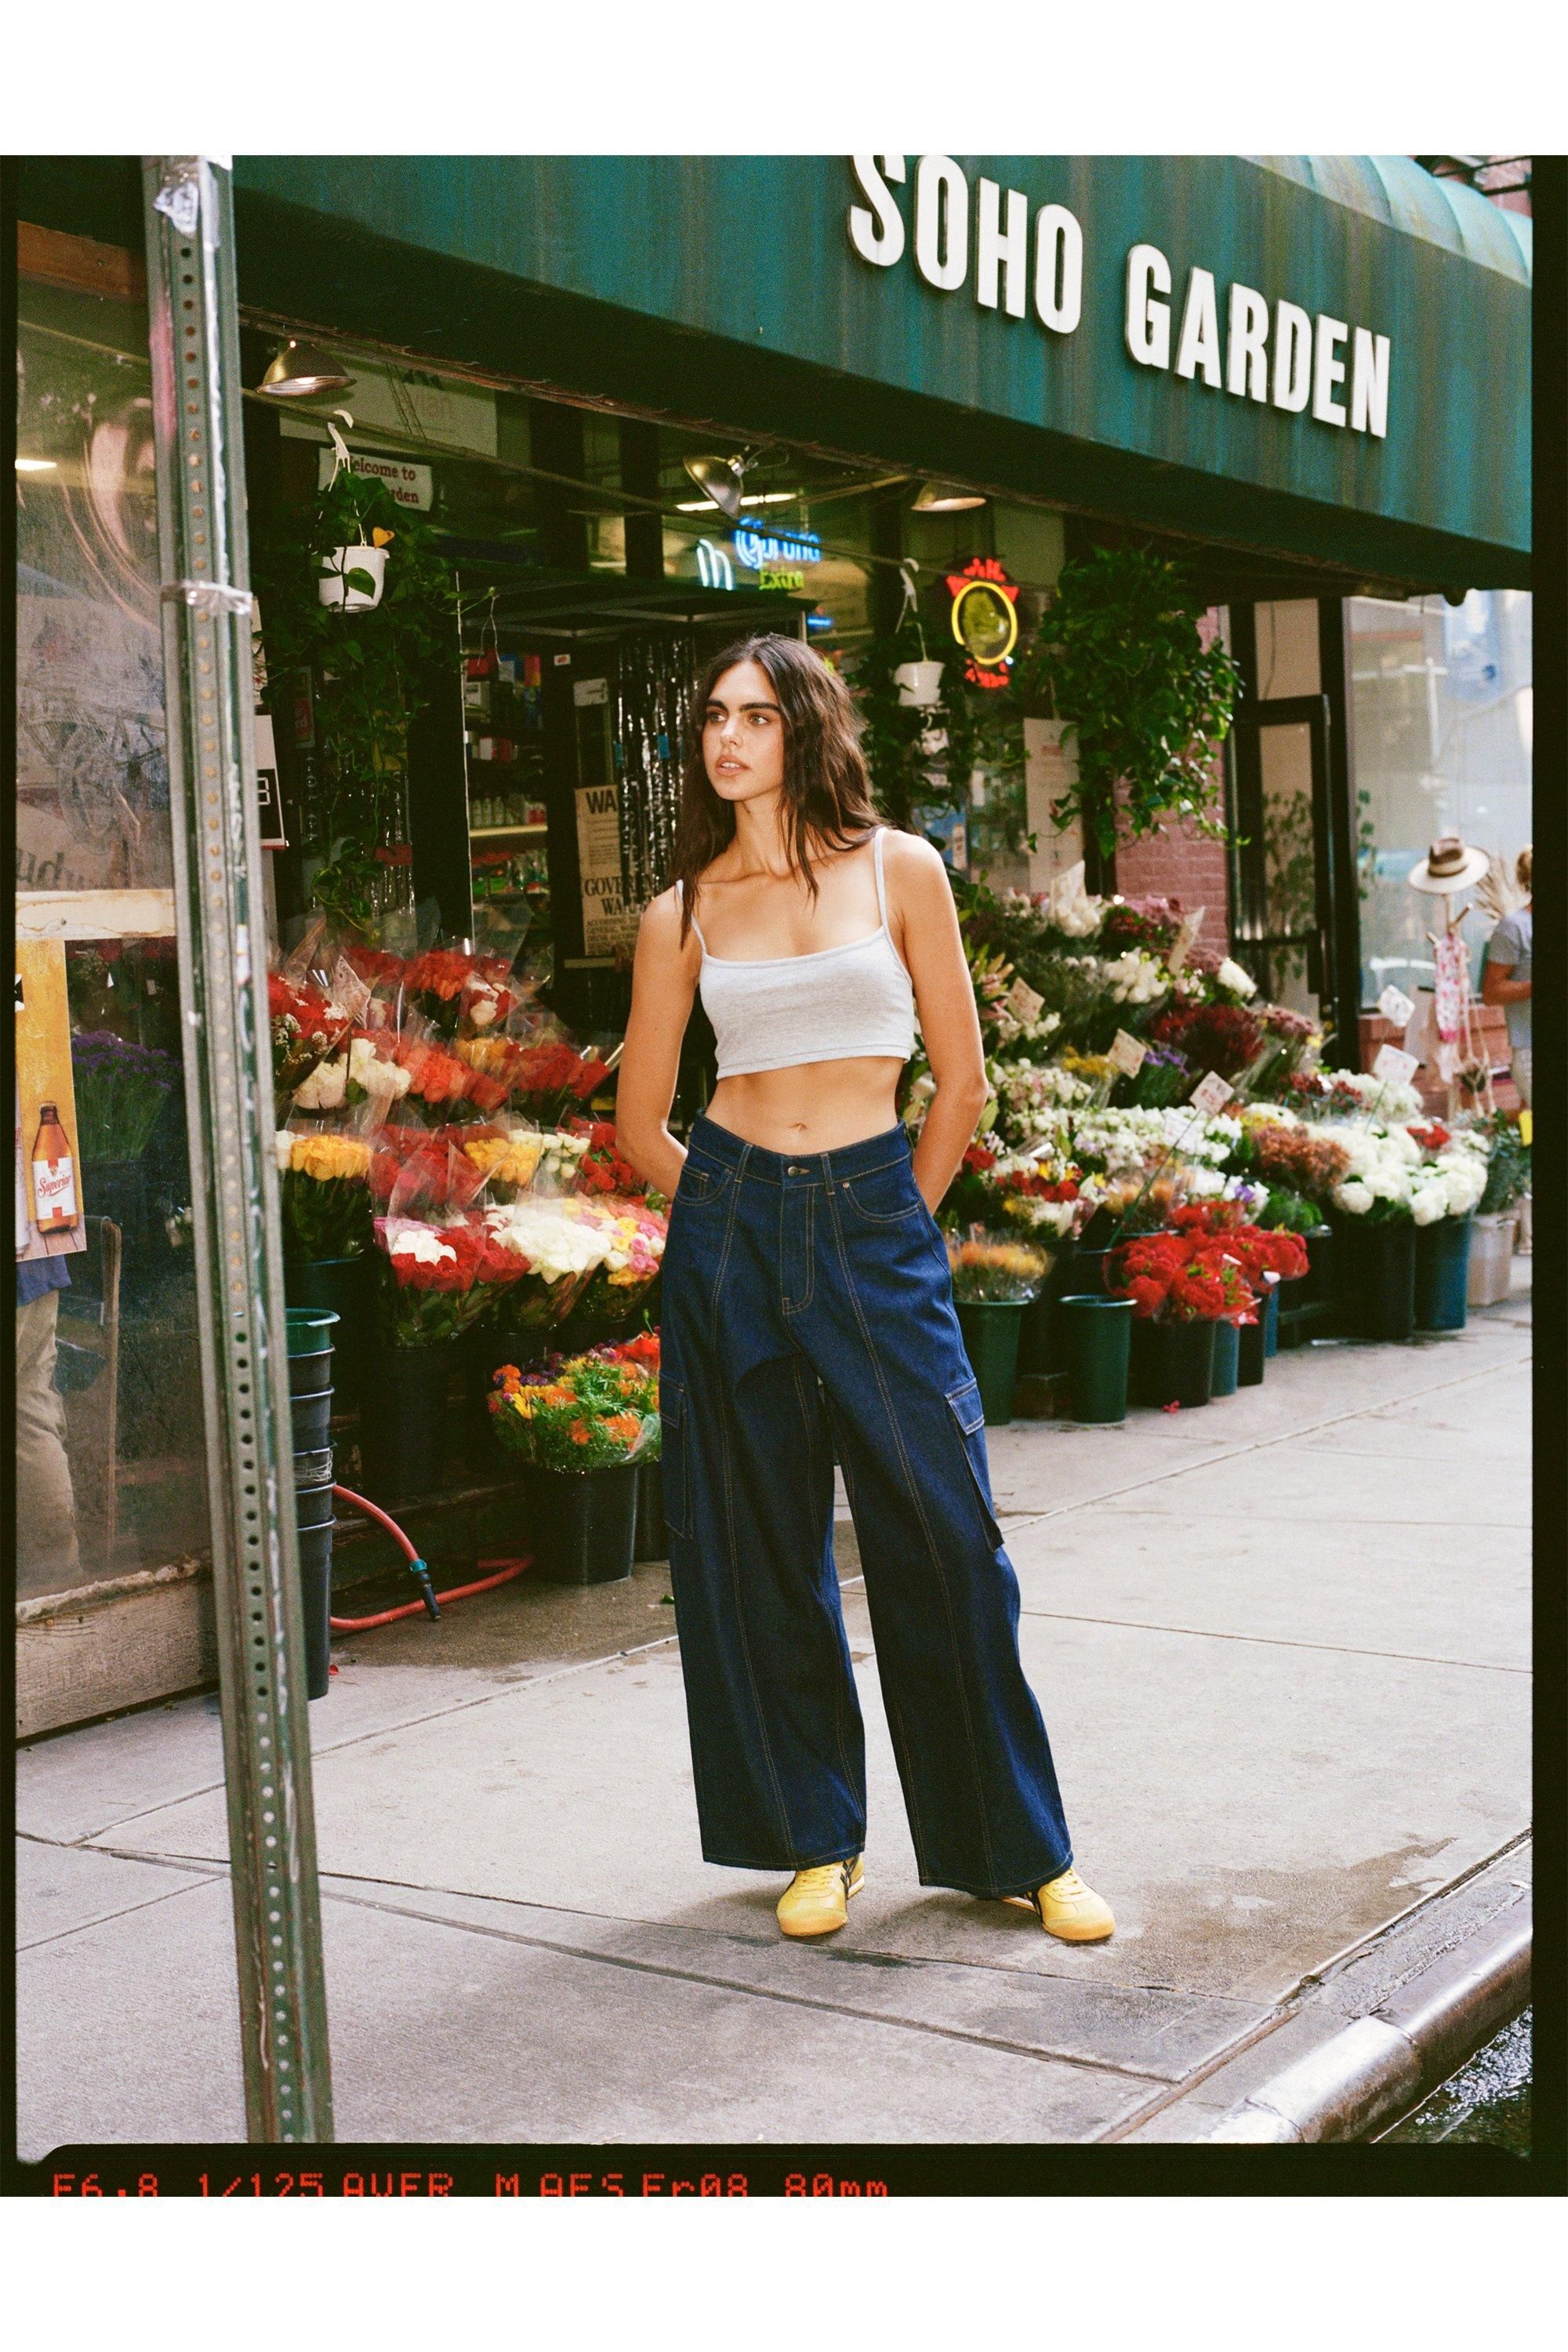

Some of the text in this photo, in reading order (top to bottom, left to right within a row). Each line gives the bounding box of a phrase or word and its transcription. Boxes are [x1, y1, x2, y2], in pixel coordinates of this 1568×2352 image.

[848, 155, 1391, 439] SOHO GARDEN
[402, 466, 416, 481] to
[37, 1175, 71, 1198] Superior
